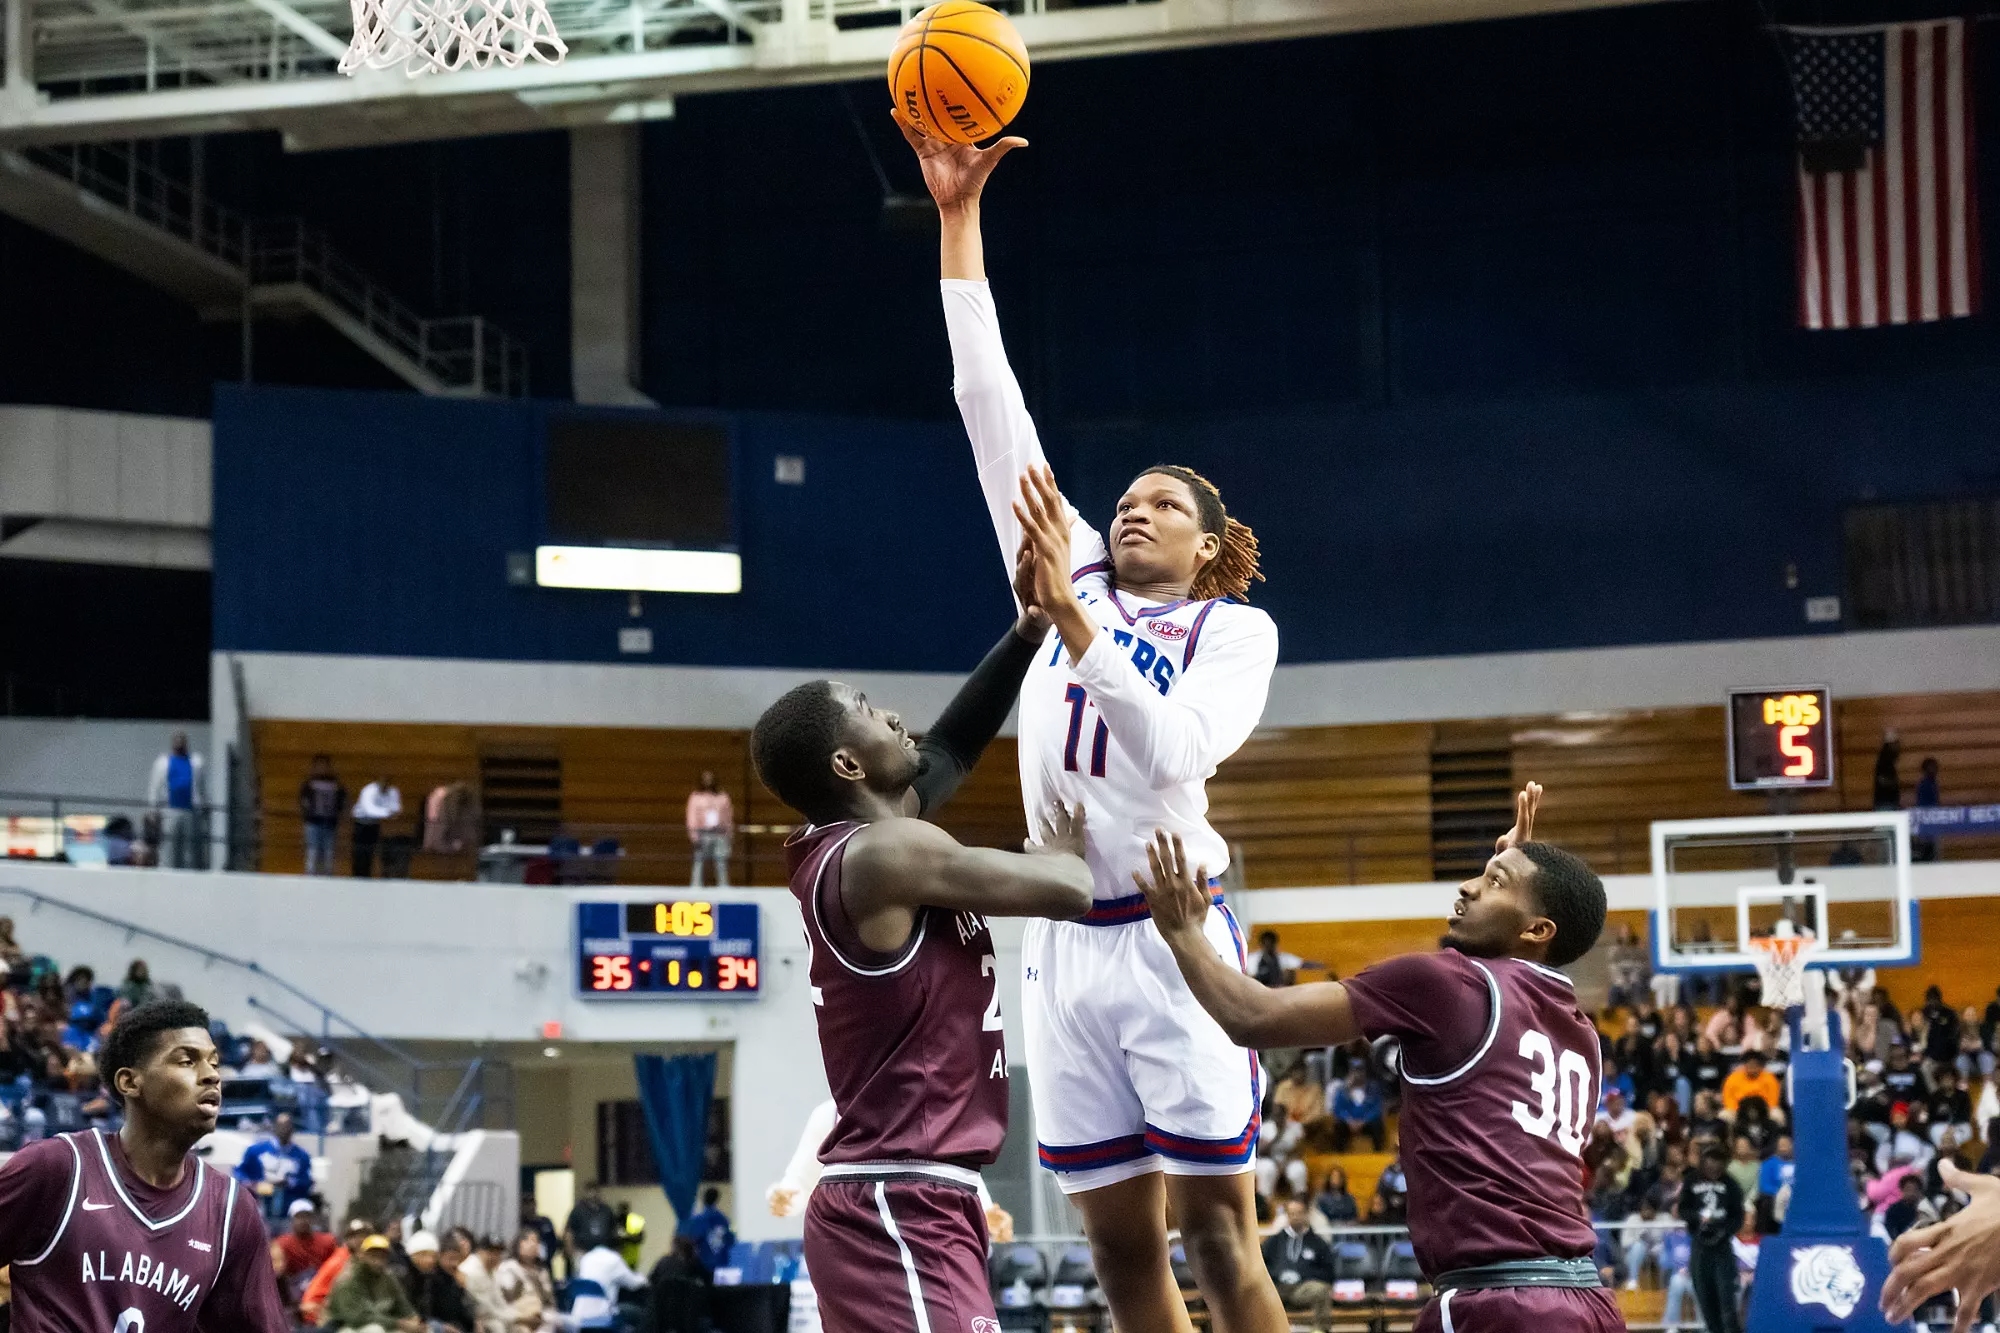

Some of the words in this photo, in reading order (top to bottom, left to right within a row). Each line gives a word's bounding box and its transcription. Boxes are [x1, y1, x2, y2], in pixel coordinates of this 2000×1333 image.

[1049, 626, 1175, 696] TERS
[1763, 695, 1820, 725] 1:05
[1780, 725, 1813, 776] 5
[655, 901, 714, 936] 1:05
[593, 956, 632, 990] 35
[718, 956, 757, 990] 34
[1511, 1028, 1591, 1158] 30
[82, 1250, 200, 1312] ALABAMA
